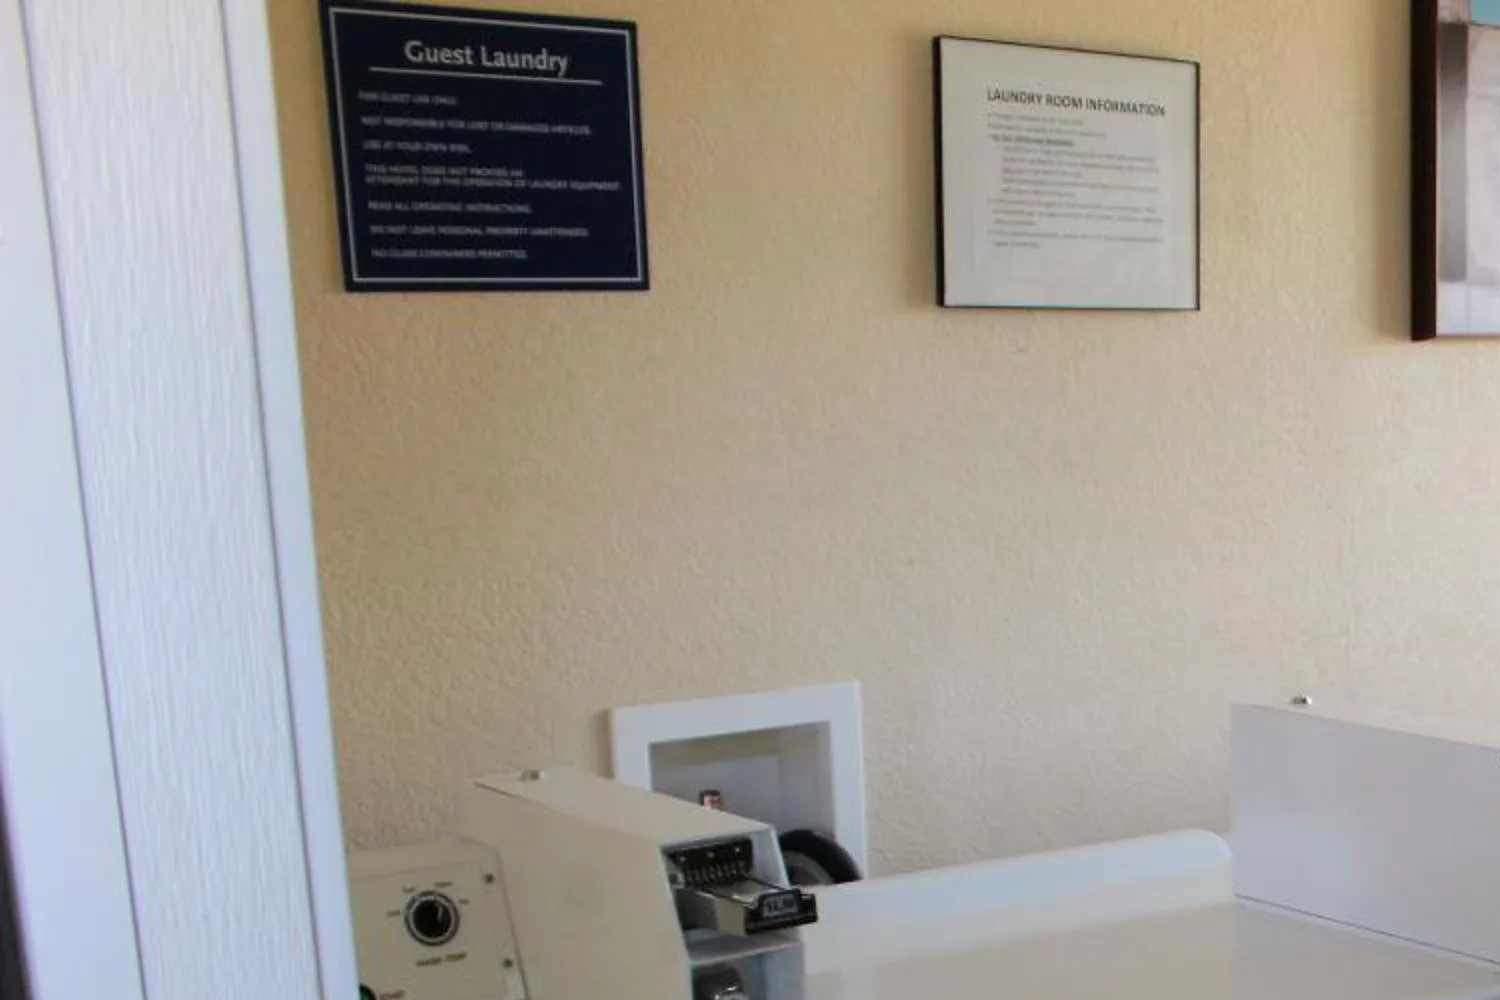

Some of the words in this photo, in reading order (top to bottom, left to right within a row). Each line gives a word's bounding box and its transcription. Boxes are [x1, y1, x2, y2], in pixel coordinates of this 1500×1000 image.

[404, 40, 475, 66] Guest
[481, 46, 569, 79] Laundry
[986, 87, 1043, 106] LAUNDRY
[1045, 92, 1083, 110] ROOM
[1085, 95, 1166, 118] INFORMATION
